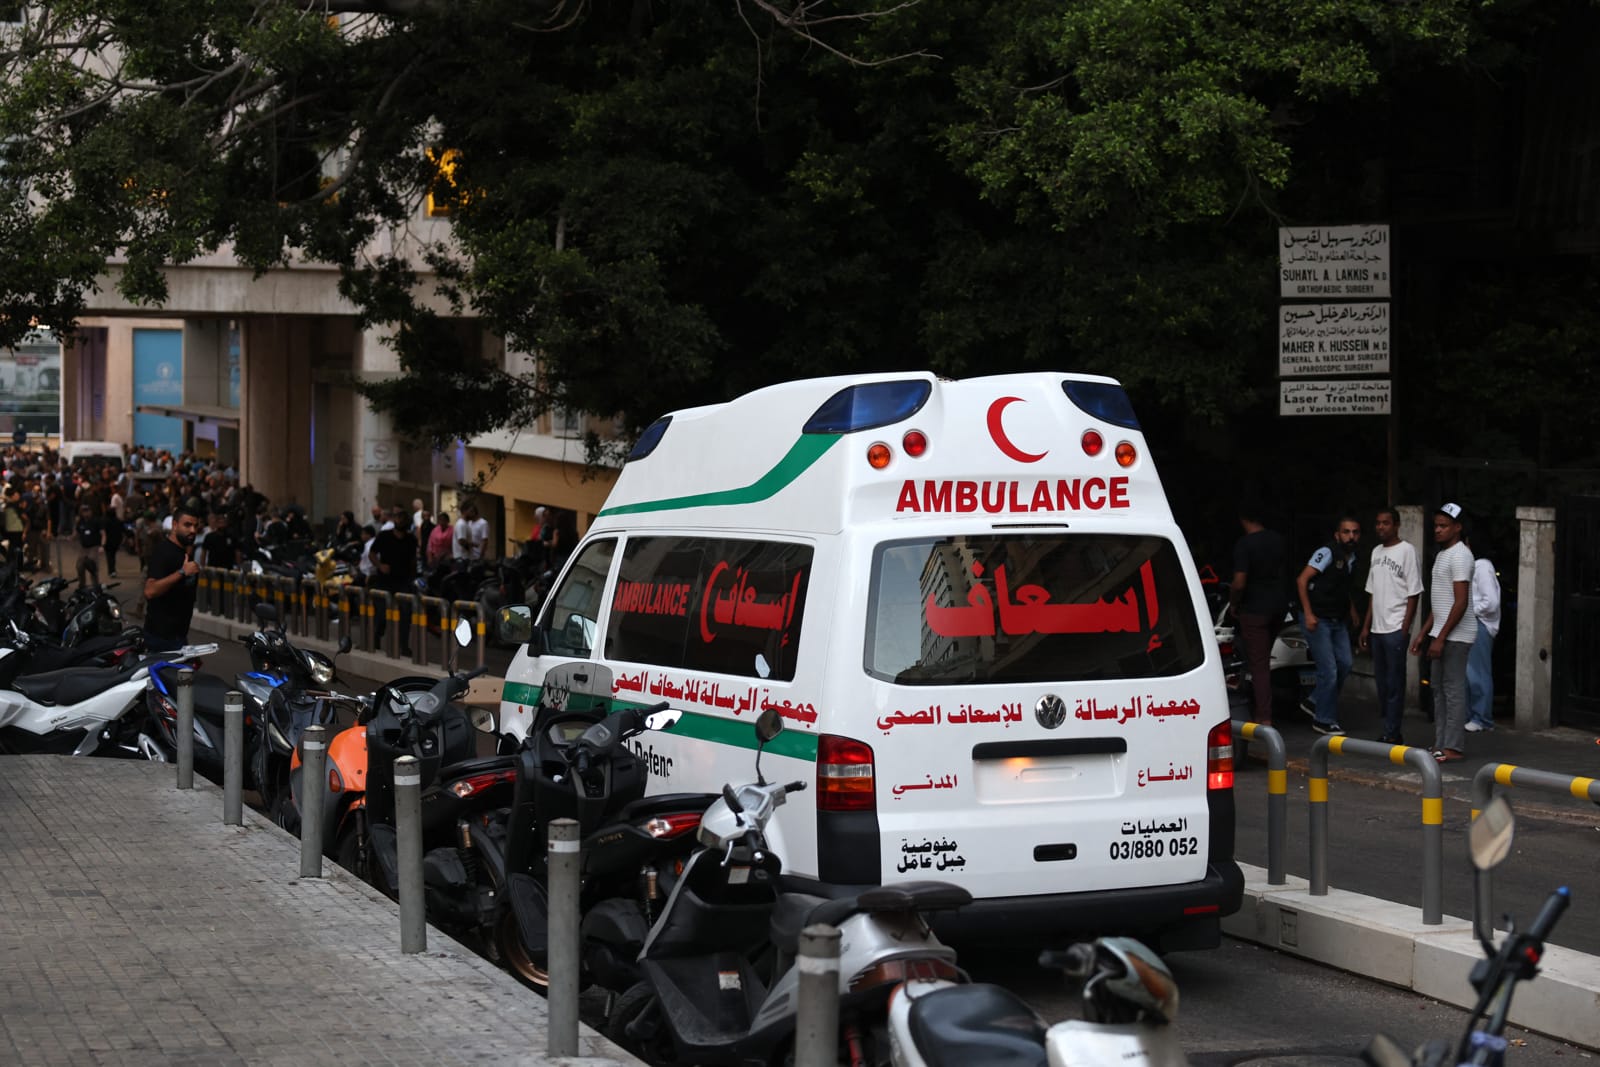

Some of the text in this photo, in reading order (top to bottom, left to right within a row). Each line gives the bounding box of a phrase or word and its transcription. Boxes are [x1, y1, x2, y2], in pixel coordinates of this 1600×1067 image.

[1321, 231, 1354, 248] سهيل
[1351, 229, 1386, 247] الدكتور
[1282, 269, 1318, 281] SUHAYL
[1336, 269, 1369, 281] LAKKIS
[1345, 285, 1374, 293] SURGERY
[1283, 305, 1386, 324] الدكتور ماهر خليل حسين
[1282, 341, 1314, 353] MAHER
[1330, 339, 1369, 352] HUSSEIN
[1282, 356, 1312, 364] GENERAL
[1323, 354, 1354, 362] VASCULAR
[1293, 364, 1341, 373] LAPAROSCOPIC
[1284, 393, 1388, 403] Laser Treatment
[896, 476, 1130, 513] AMBULANCE
[1314, 553, 1324, 563] 3
[613, 582, 691, 616] AMBULANCE
[714, 565, 802, 648] إسعاف
[926, 559, 1163, 654] إسعاف
[611, 671, 649, 699] الصحي
[700, 681, 757, 715] الرسالة
[877, 695, 1200, 736] جمعية الرسالة للإسعاف الصحي
[892, 762, 1192, 800] الدفاع المدني
[1121, 816, 1187, 838] العمليات
[901, 837, 958, 856] مفوضية
[1110, 837, 1198, 860] 03/880 052
[936, 853, 966, 872] جبل
